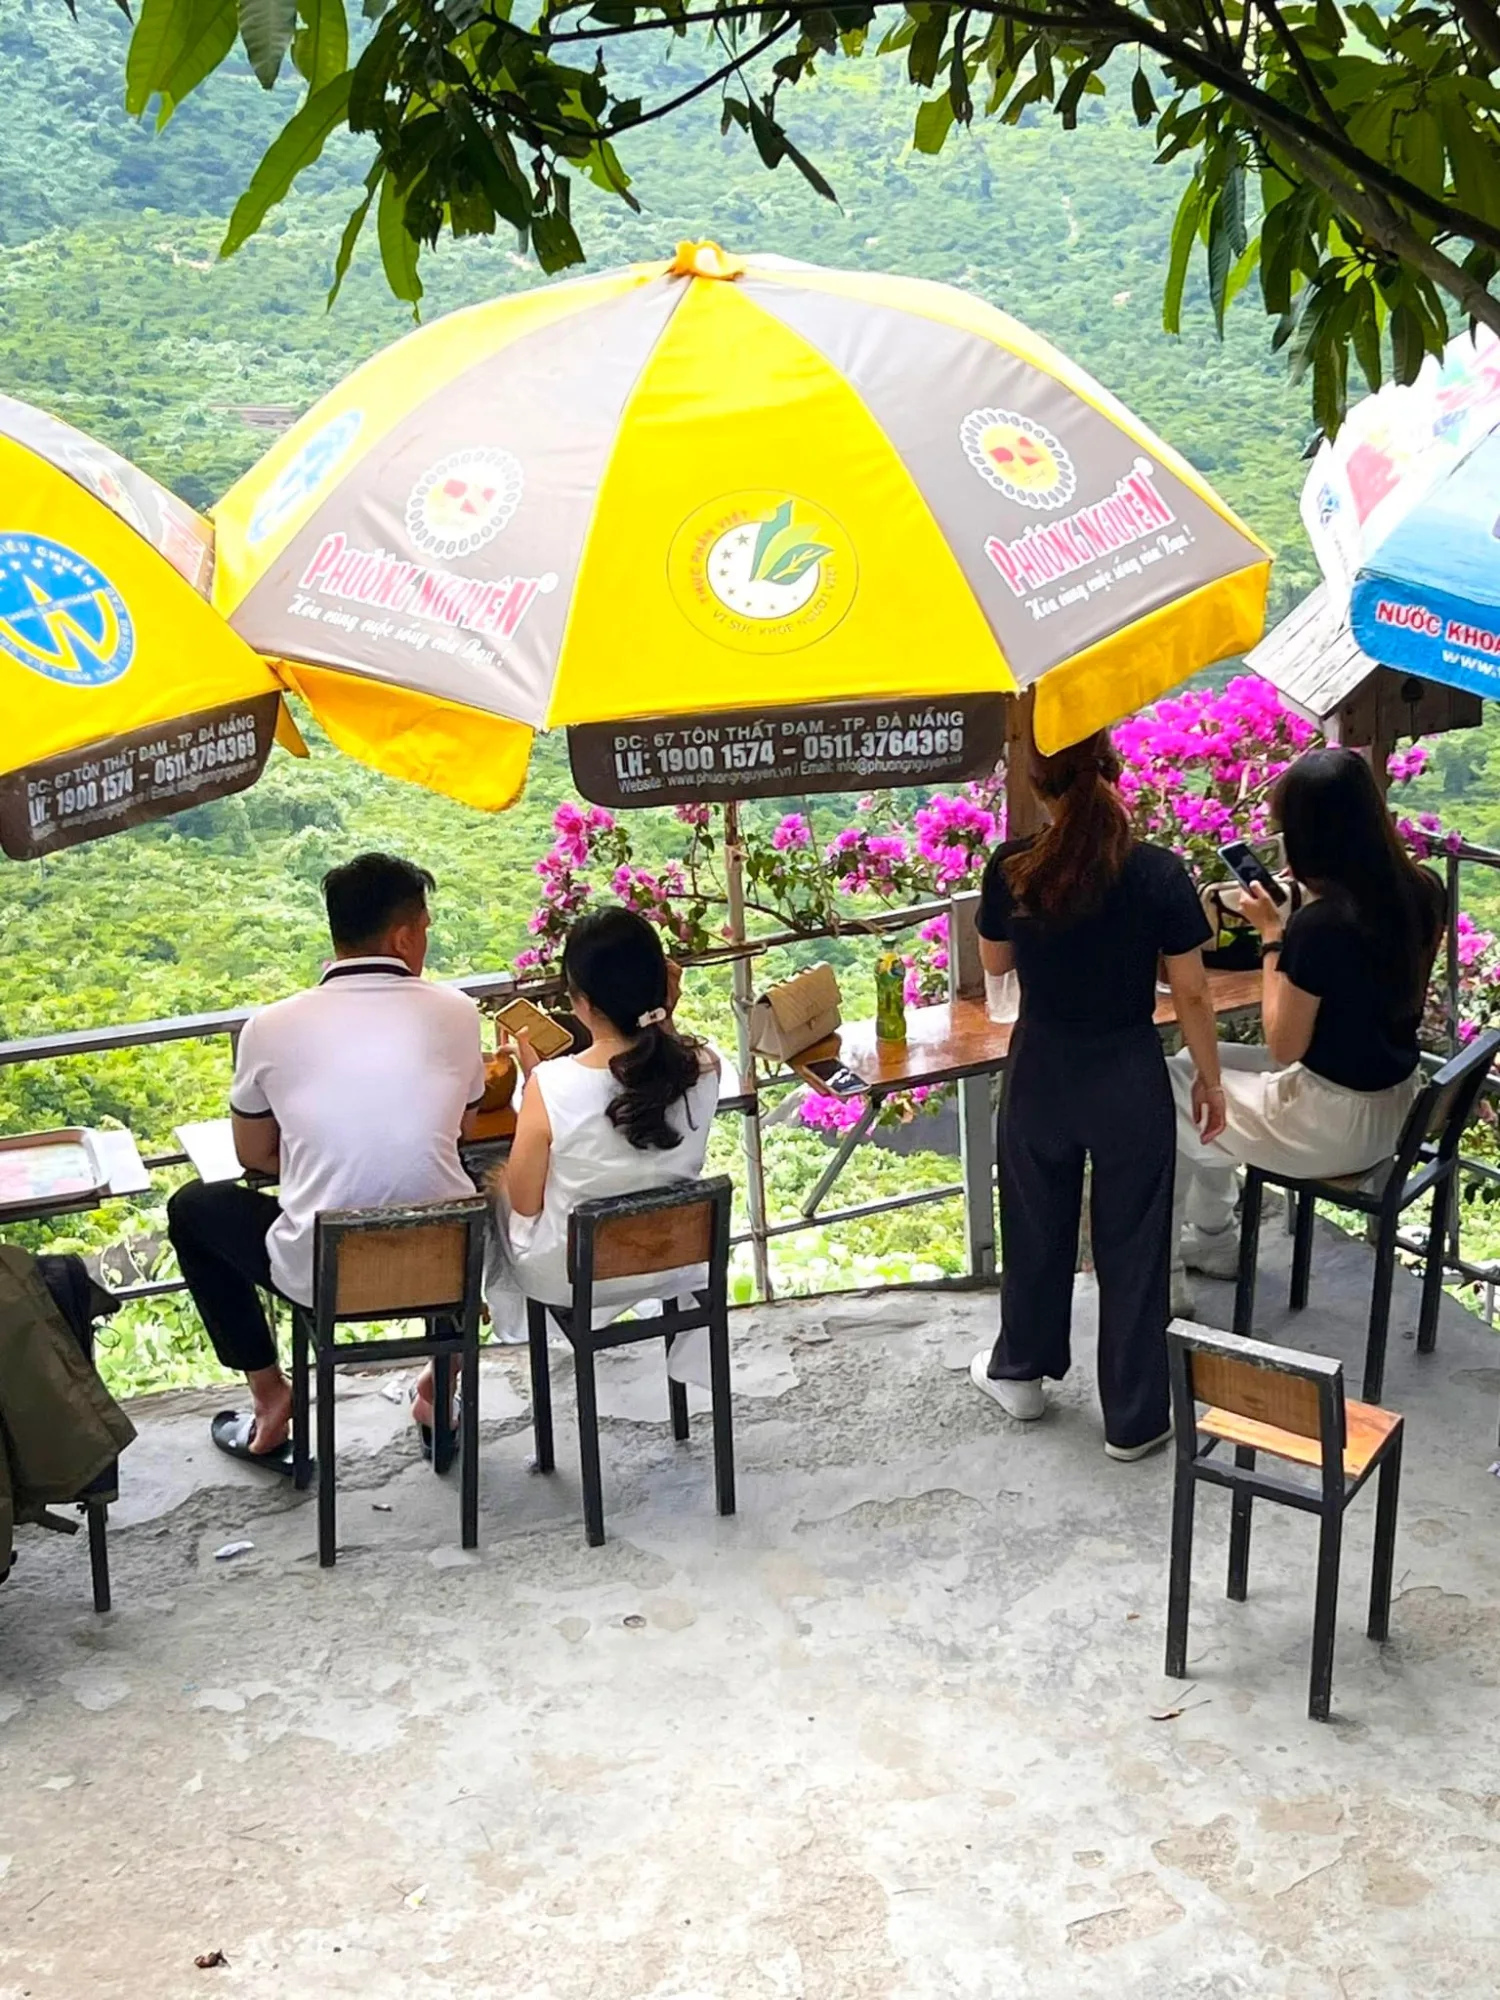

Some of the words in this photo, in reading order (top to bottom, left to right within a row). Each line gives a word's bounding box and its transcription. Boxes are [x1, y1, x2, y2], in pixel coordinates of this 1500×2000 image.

[1376, 601, 1441, 636] NƯỚC
[653, 732, 675, 747] 67
[680, 726, 720, 745] TÔN
[725, 718, 776, 741] THẤT
[842, 717, 871, 732] TP.
[876, 711, 902, 730] ĐÀ
[54, 771, 71, 789] 67
[73, 761, 100, 783] TÔN
[103, 746, 137, 774] THẤT
[56, 781, 97, 817] 1900
[101, 767, 133, 803] 1574
[155, 730, 256, 785] 0511.3764369
[615, 751, 652, 779] LH:
[657, 745, 715, 773] 1900
[721, 739, 775, 769] 1574
[804, 729, 963, 760] 0511.3764369
